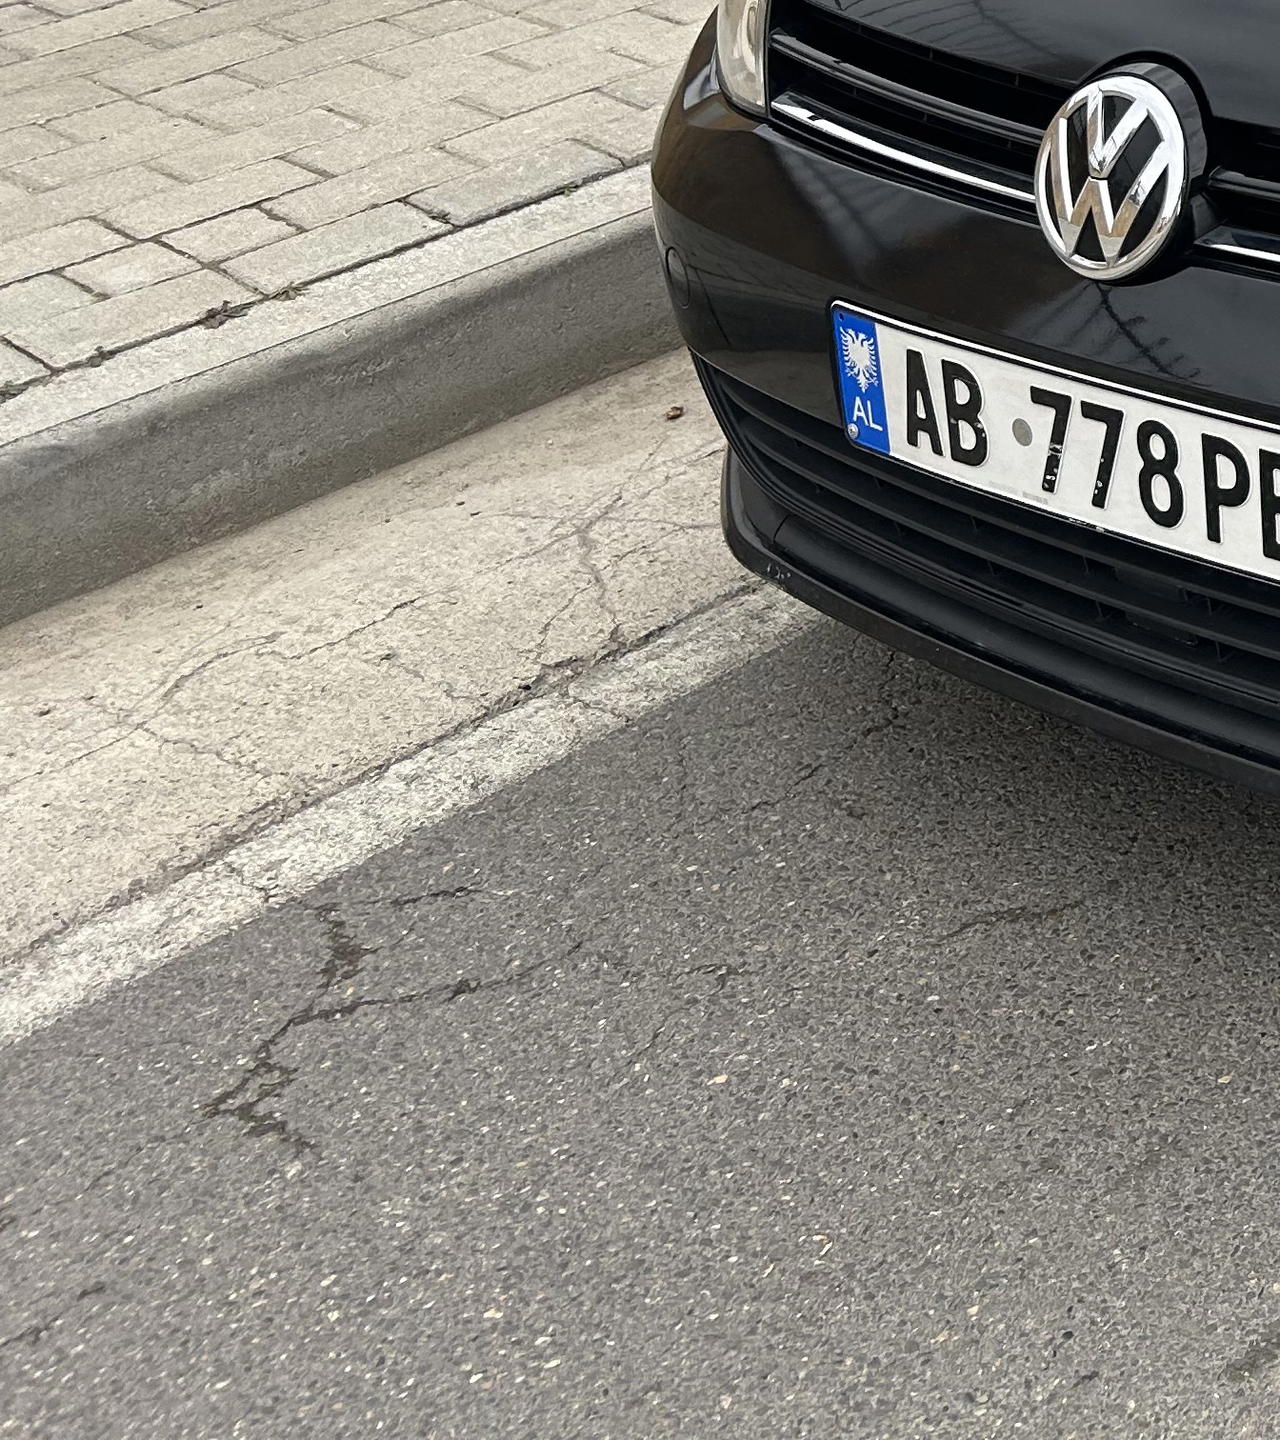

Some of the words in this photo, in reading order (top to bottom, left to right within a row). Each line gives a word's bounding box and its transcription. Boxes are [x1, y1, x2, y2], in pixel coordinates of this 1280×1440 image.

[1042, 81, 1178, 272] VW
[853, 396, 883, 432] AL
[906, 348, 988, 467] AB
